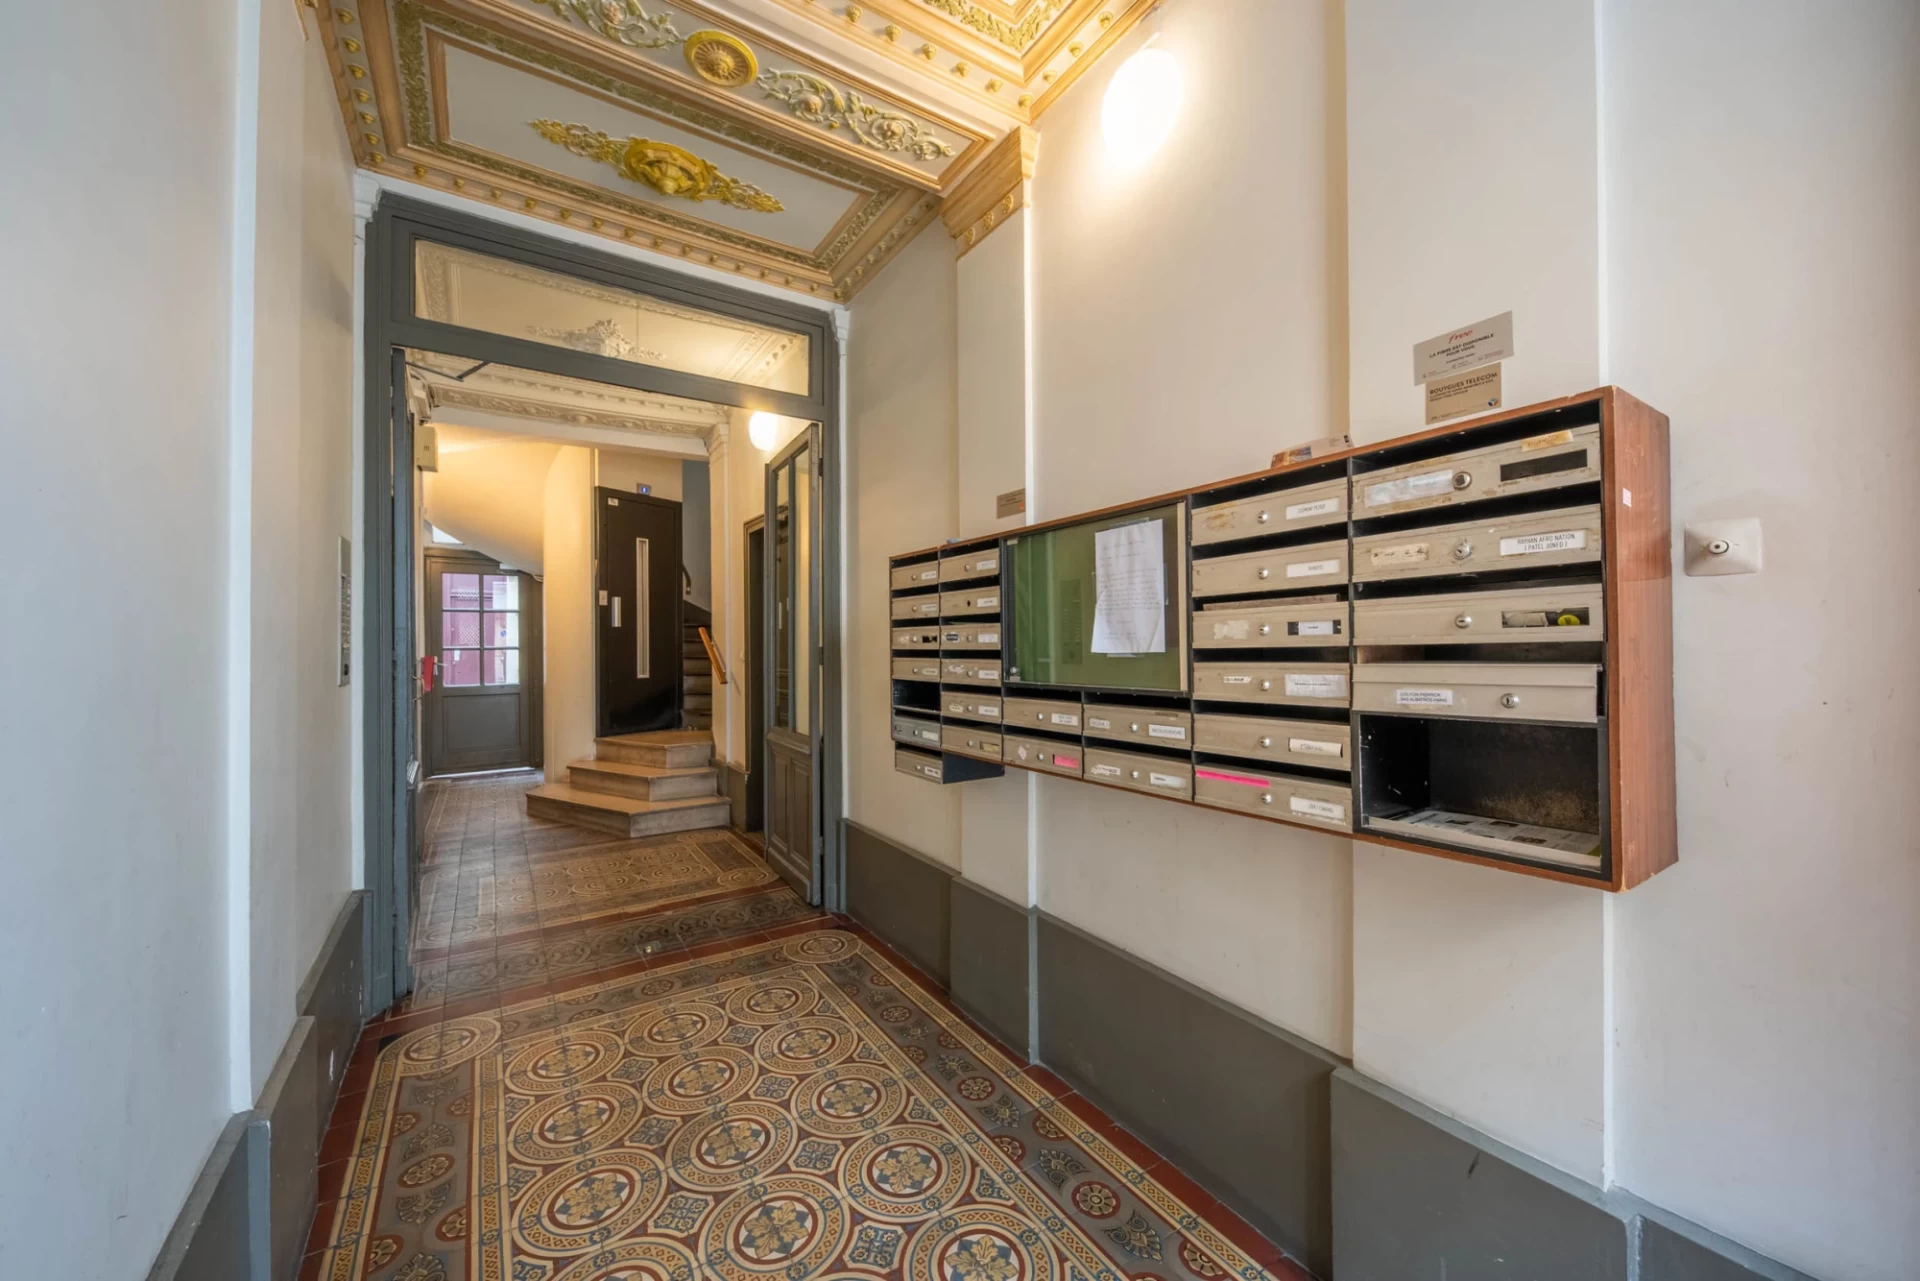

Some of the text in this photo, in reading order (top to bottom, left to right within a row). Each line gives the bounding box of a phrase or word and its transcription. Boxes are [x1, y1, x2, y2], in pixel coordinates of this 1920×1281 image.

[1448, 330, 1473, 344] free
[1462, 333, 1494, 347] DISPONIBLE
[1429, 381, 1464, 394] BOUYGUES
[1465, 372, 1498, 385] TELECOM
[1538, 535, 1553, 543] AFRO
